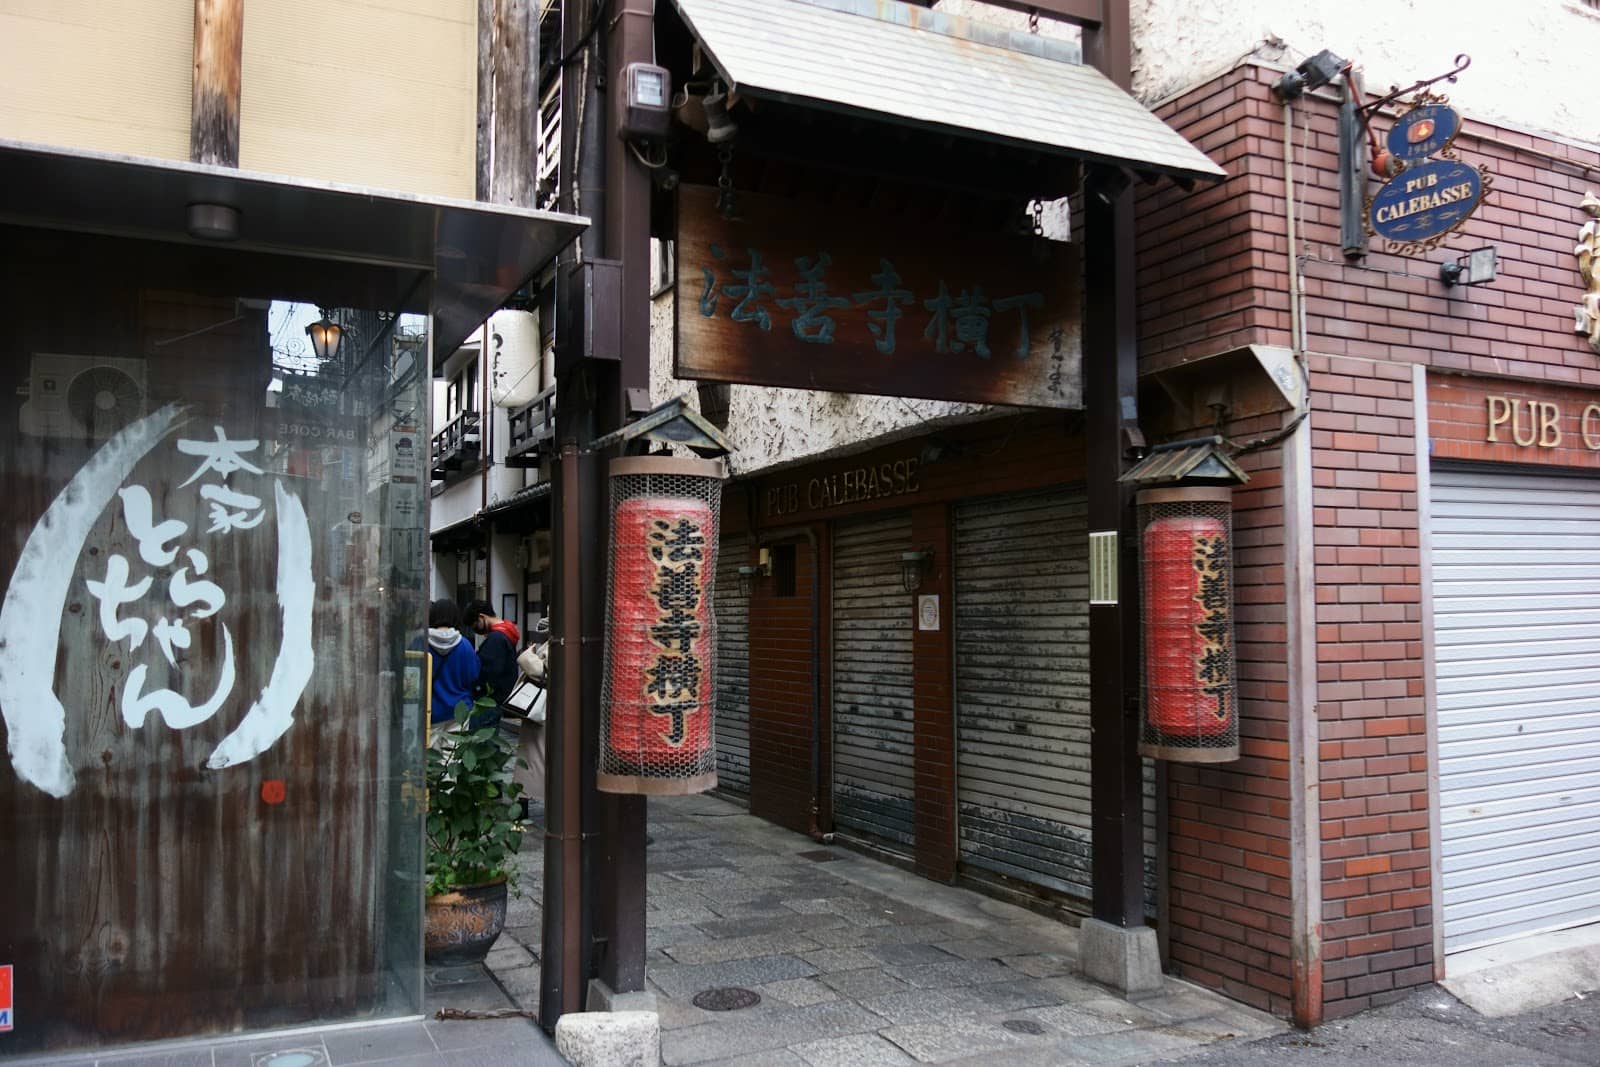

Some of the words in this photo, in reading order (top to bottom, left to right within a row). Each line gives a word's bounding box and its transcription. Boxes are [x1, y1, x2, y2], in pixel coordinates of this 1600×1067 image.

[1376, 182, 1472, 223] CALEBASSE
[1405, 173, 1438, 193] PUB
[699, 242, 1047, 360] 法善寺横丁
[1487, 396, 1562, 447] PUB
[177, 425, 264, 536] 本家
[767, 483, 799, 516] PUB
[807, 457, 920, 510] CALEBASSE
[648, 518, 705, 745] 法善寺横丁
